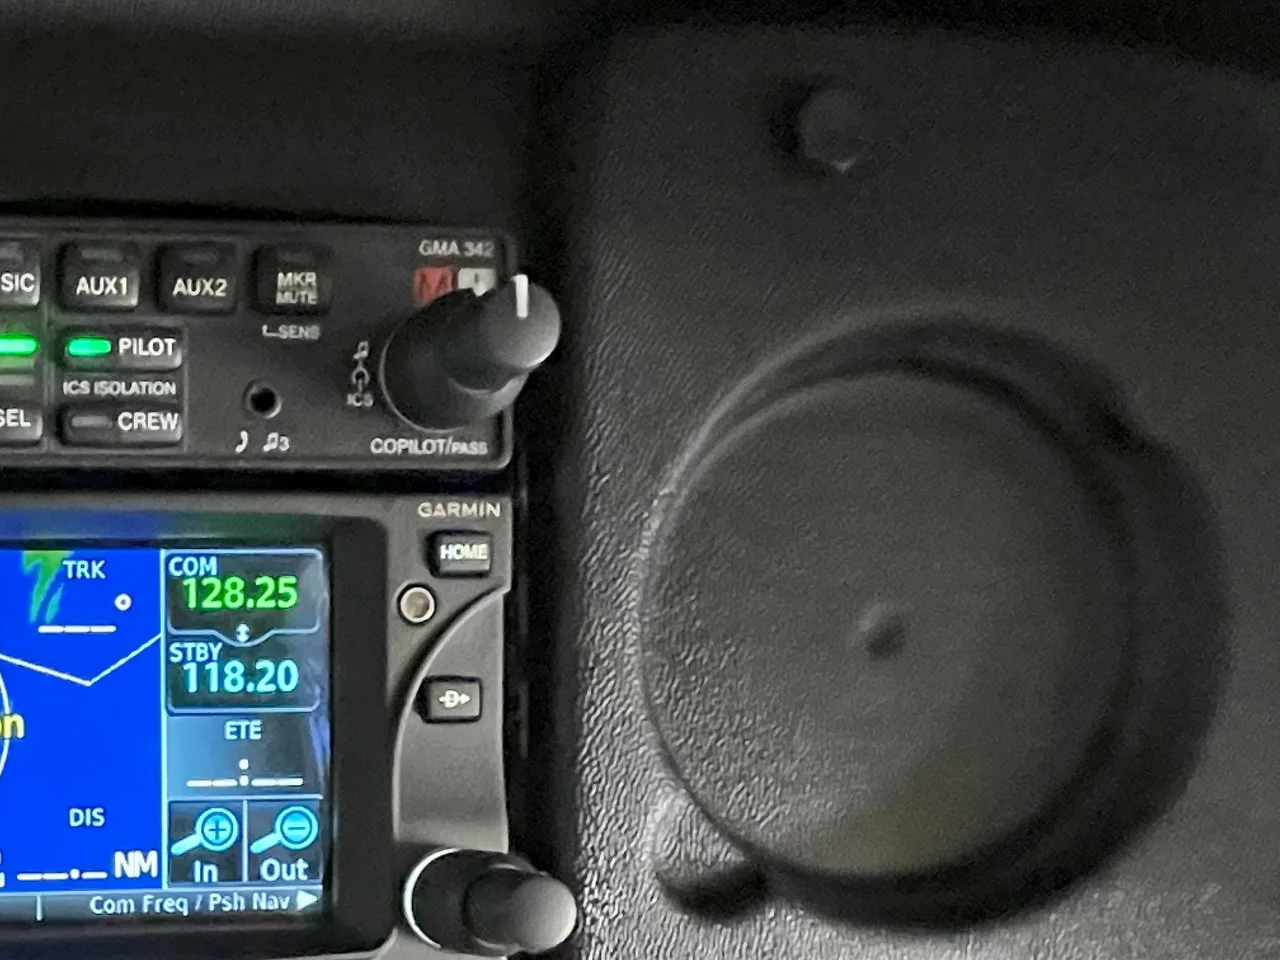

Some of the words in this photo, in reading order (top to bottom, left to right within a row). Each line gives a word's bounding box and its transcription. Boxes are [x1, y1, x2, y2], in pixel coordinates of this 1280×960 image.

[419, 239, 460, 256] GMA
[463, 241, 495, 258] 342
[76, 277, 129, 296] AUX1
[172, 278, 227, 298] AUX2
[277, 272, 317, 289] MKR
[276, 289, 318, 306] MUTE
[279, 325, 320, 341] SENS
[119, 338, 176, 357] PILOT
[62, 381, 92, 395] ICS
[94, 380, 176, 396] ISOLATION
[118, 411, 179, 431] CREW
[370, 438, 488, 457] COPILOT/PASS
[418, 501, 501, 518] GARMIN
[440, 543, 488, 560] HOME
[63, 560, 106, 580] TRK
[169, 556, 218, 576] COM
[183, 576, 298, 609] 128.25
[169, 642, 223, 663] STBY
[183, 659, 299, 693] 118.20
[225, 720, 262, 740] ETE
[69, 807, 105, 827] DIS
[114, 850, 158, 878] NM
[194, 861, 219, 883] In
[260, 858, 308, 882] Out
[89, 896, 135, 915] Com
[143, 895, 189, 916] Freq
[209, 893, 245, 912] Psh
[252, 893, 291, 911] Nav
